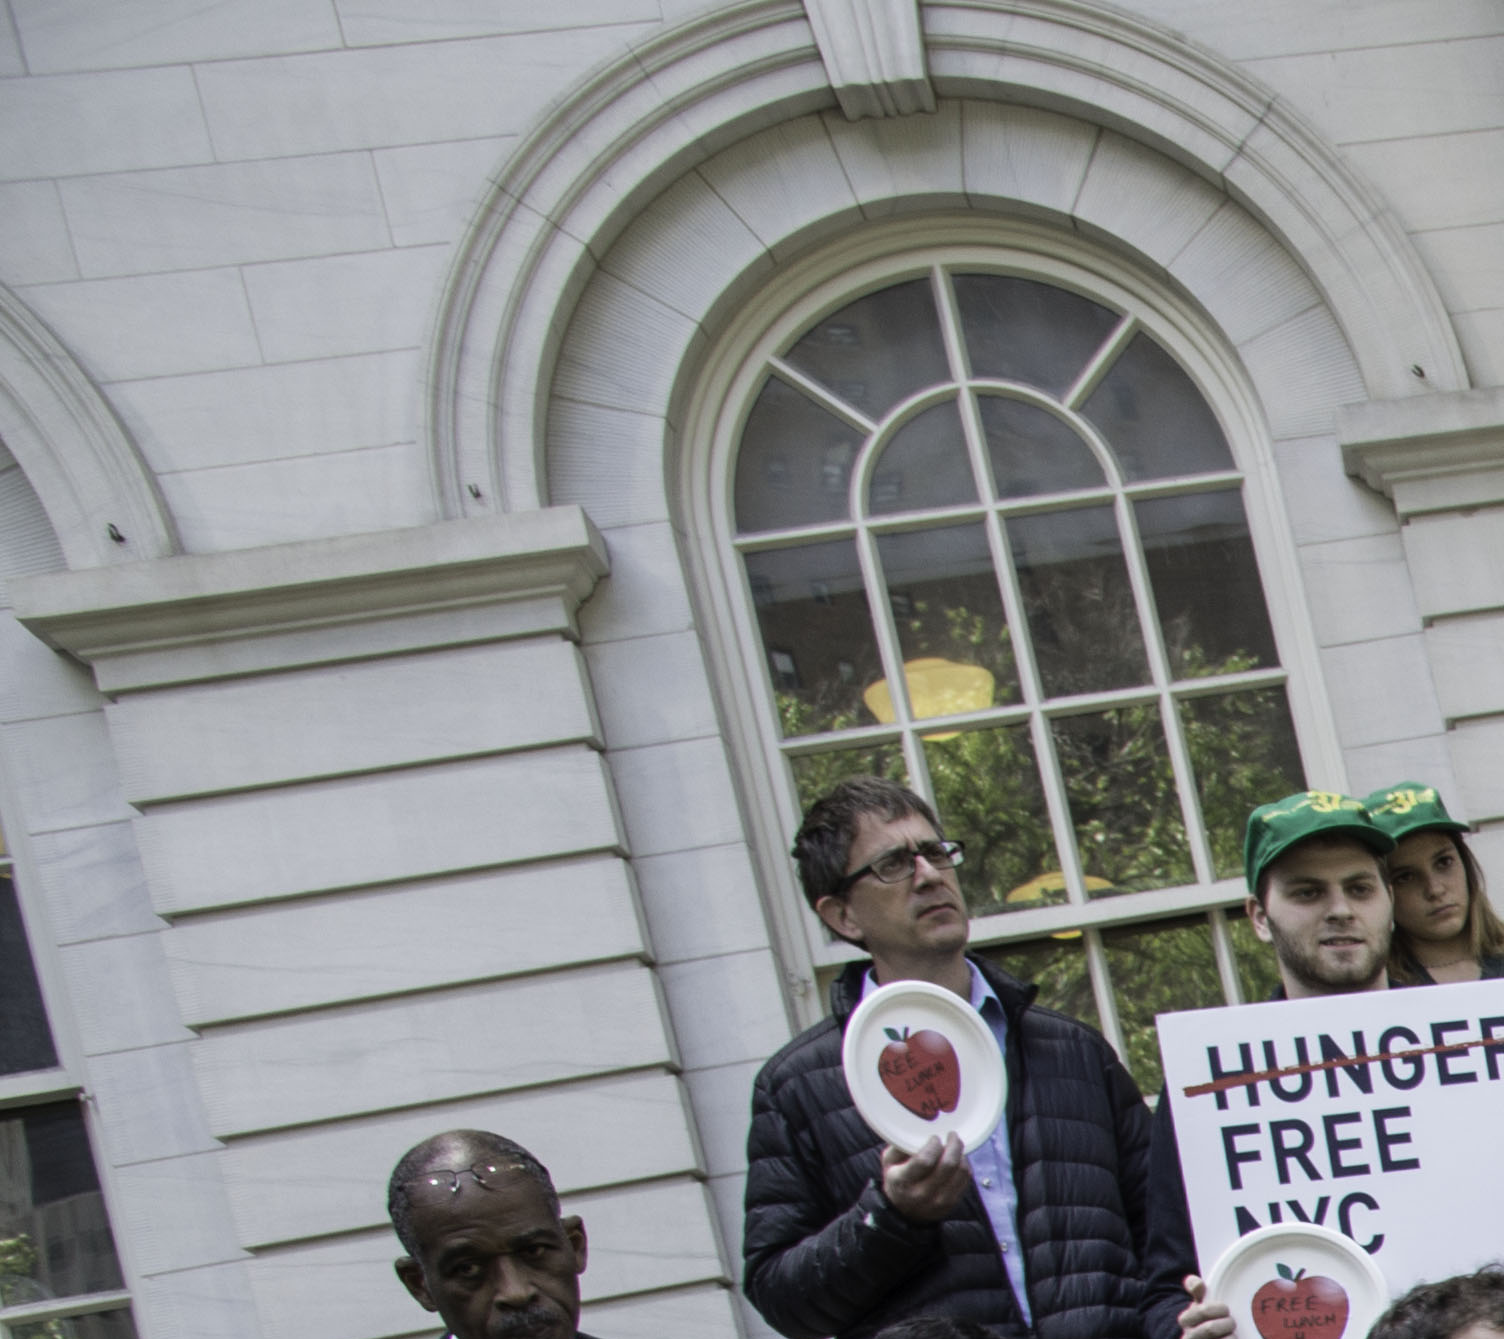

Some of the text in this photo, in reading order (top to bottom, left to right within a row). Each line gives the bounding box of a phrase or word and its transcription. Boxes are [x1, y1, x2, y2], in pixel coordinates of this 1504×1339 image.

[1220, 1104, 1421, 1190] FREE
[1260, 1295, 1320, 1315] FREE
[1283, 1313, 1337, 1329] LUNCH
